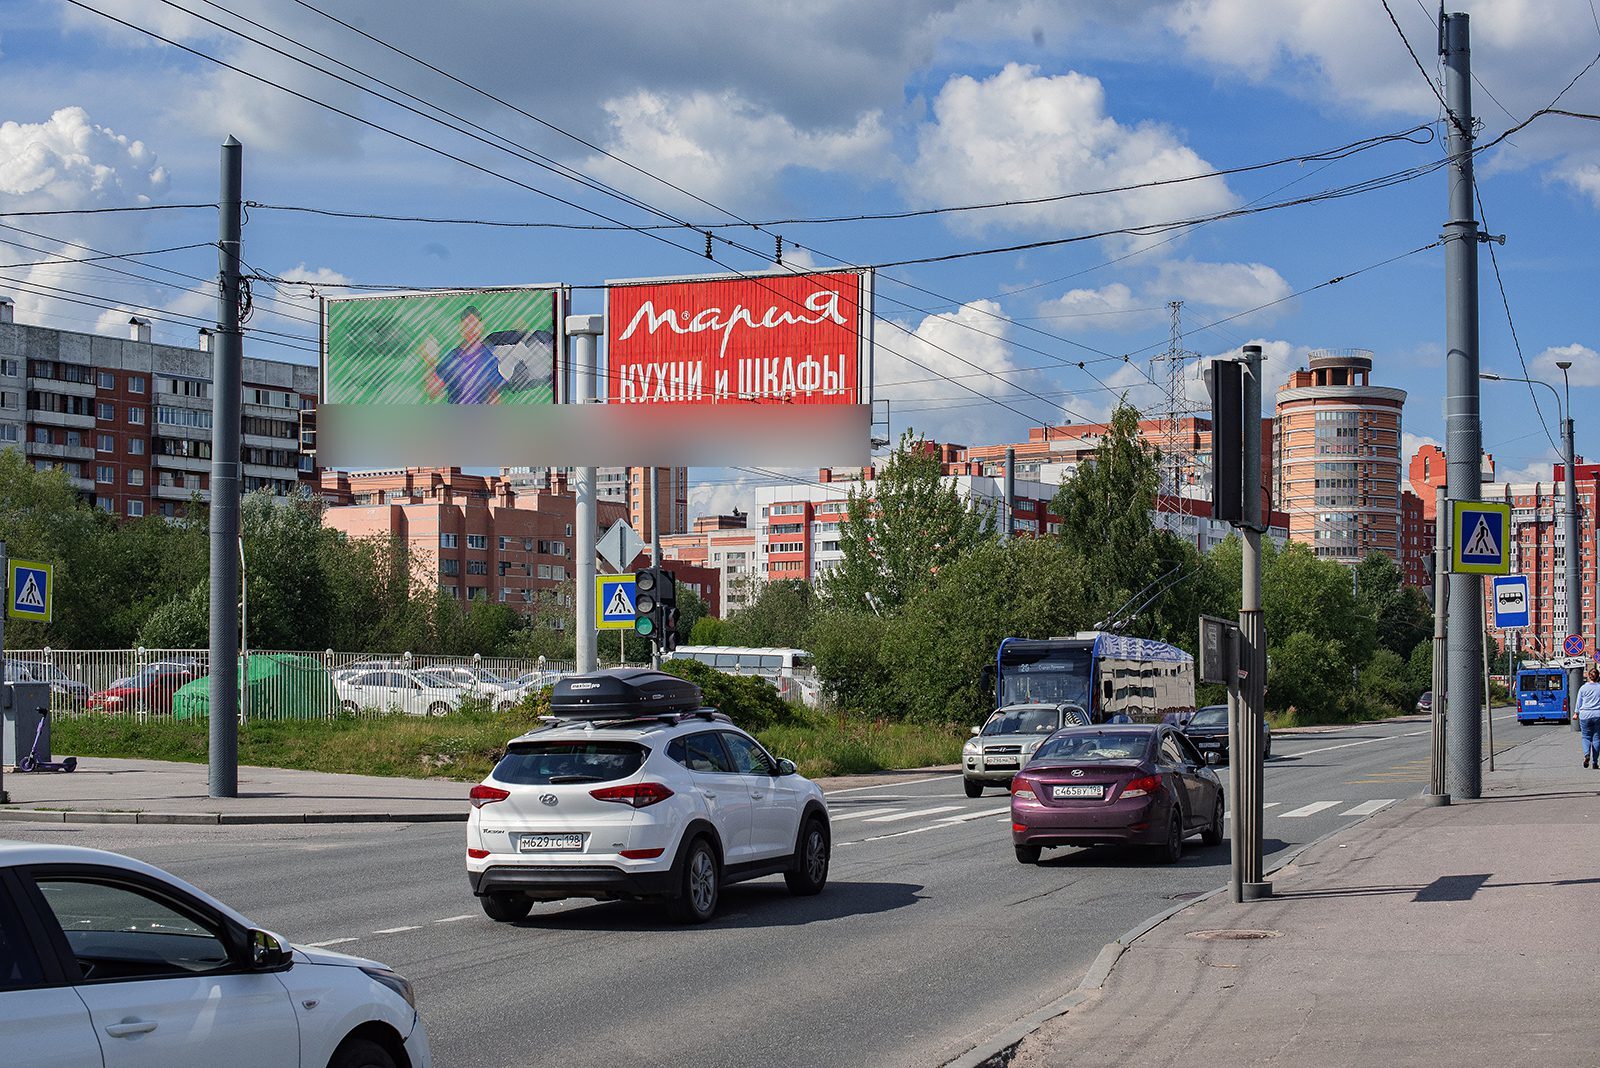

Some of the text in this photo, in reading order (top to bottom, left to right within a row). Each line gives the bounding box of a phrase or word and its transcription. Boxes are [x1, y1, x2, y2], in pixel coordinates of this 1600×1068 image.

[620, 354, 845, 404] КУХНИ и ШКАФЫ
[522, 835, 580, 848] М629ТС 198
